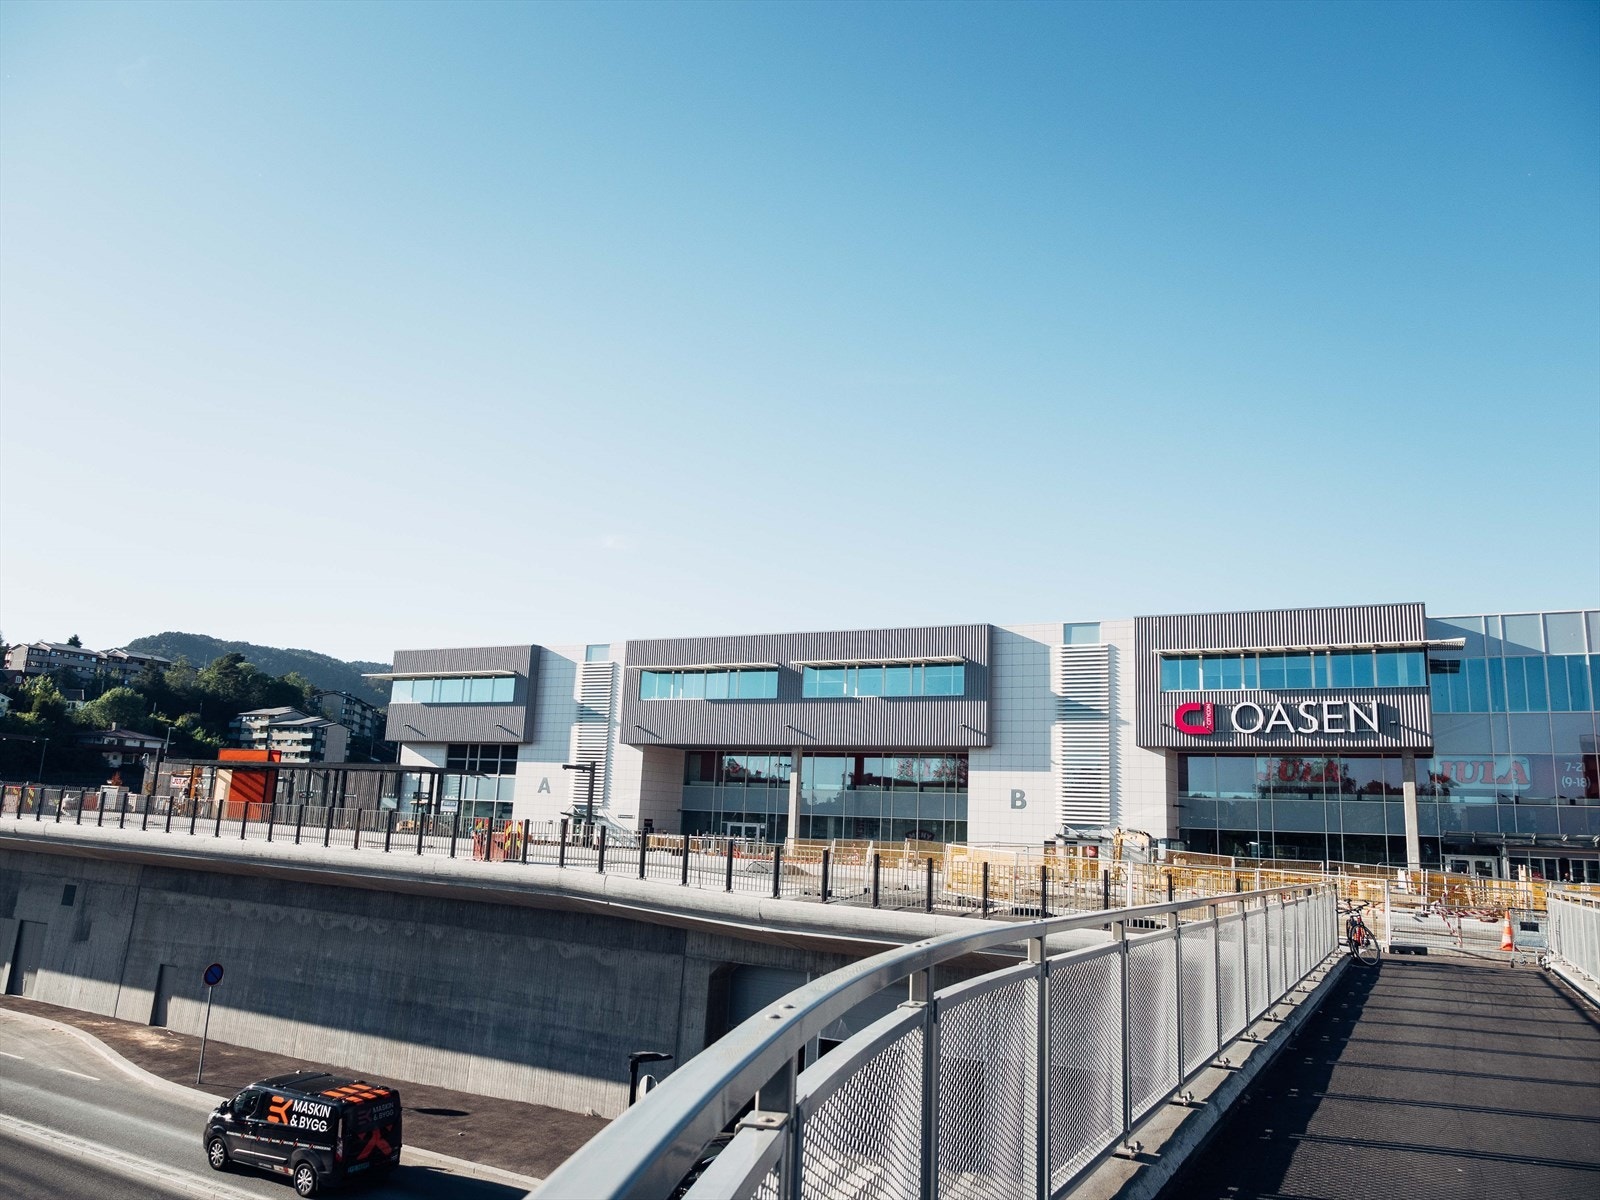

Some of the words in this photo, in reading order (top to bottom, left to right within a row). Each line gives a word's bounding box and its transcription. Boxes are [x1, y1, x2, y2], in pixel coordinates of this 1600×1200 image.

[1231, 701, 1379, 734] OASEN
[1257, 760, 1342, 782] JULA
[1433, 761, 1529, 785] JULA
[537, 777, 551, 794] A
[1010, 789, 1027, 809] B
[293, 1100, 331, 1118] MASKIN
[290, 1114, 298, 1127] &
[300, 1116, 327, 1132] BYGG
